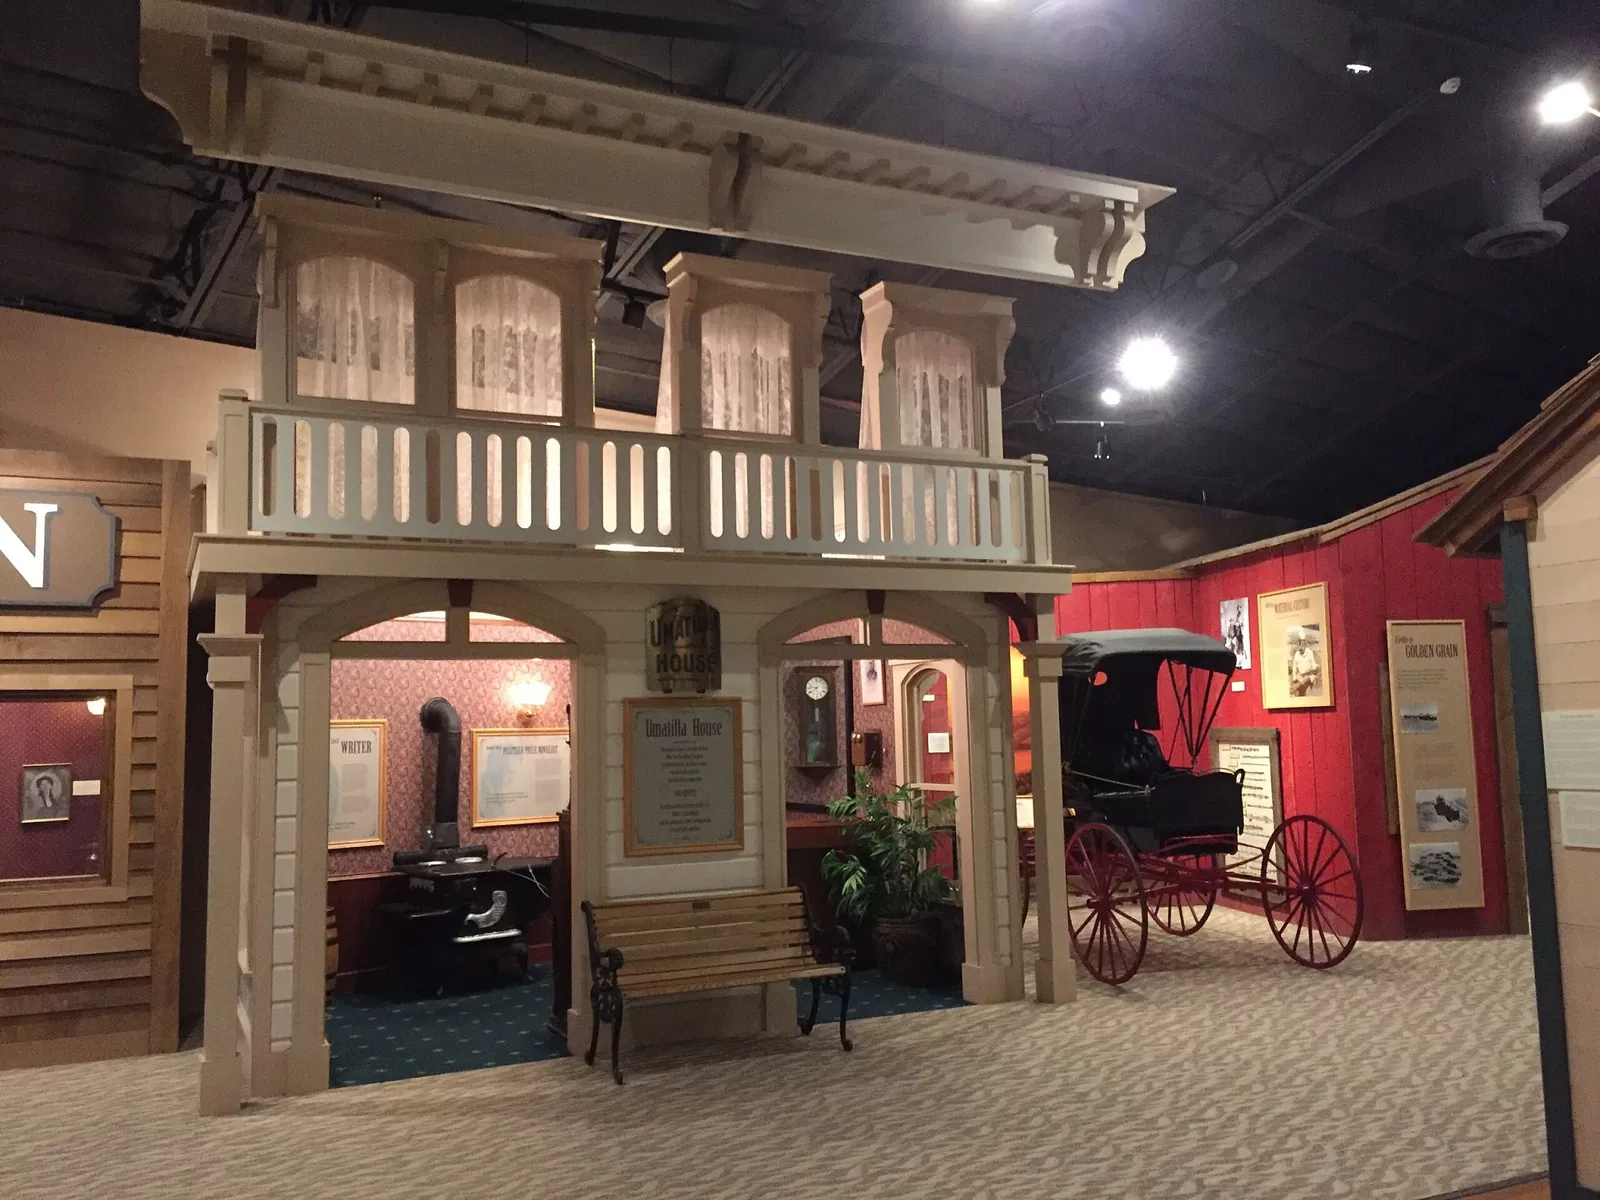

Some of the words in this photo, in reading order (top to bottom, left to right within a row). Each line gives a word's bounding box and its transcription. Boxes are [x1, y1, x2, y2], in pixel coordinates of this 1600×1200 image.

[1405, 644, 1434, 658] GOLDEN
[1435, 644, 1458, 658] GRAIN
[656, 654, 717, 673] HOUSE
[645, 719, 687, 738] Umatilla
[692, 718, 723, 737] House
[341, 740, 372, 754] WRITER
